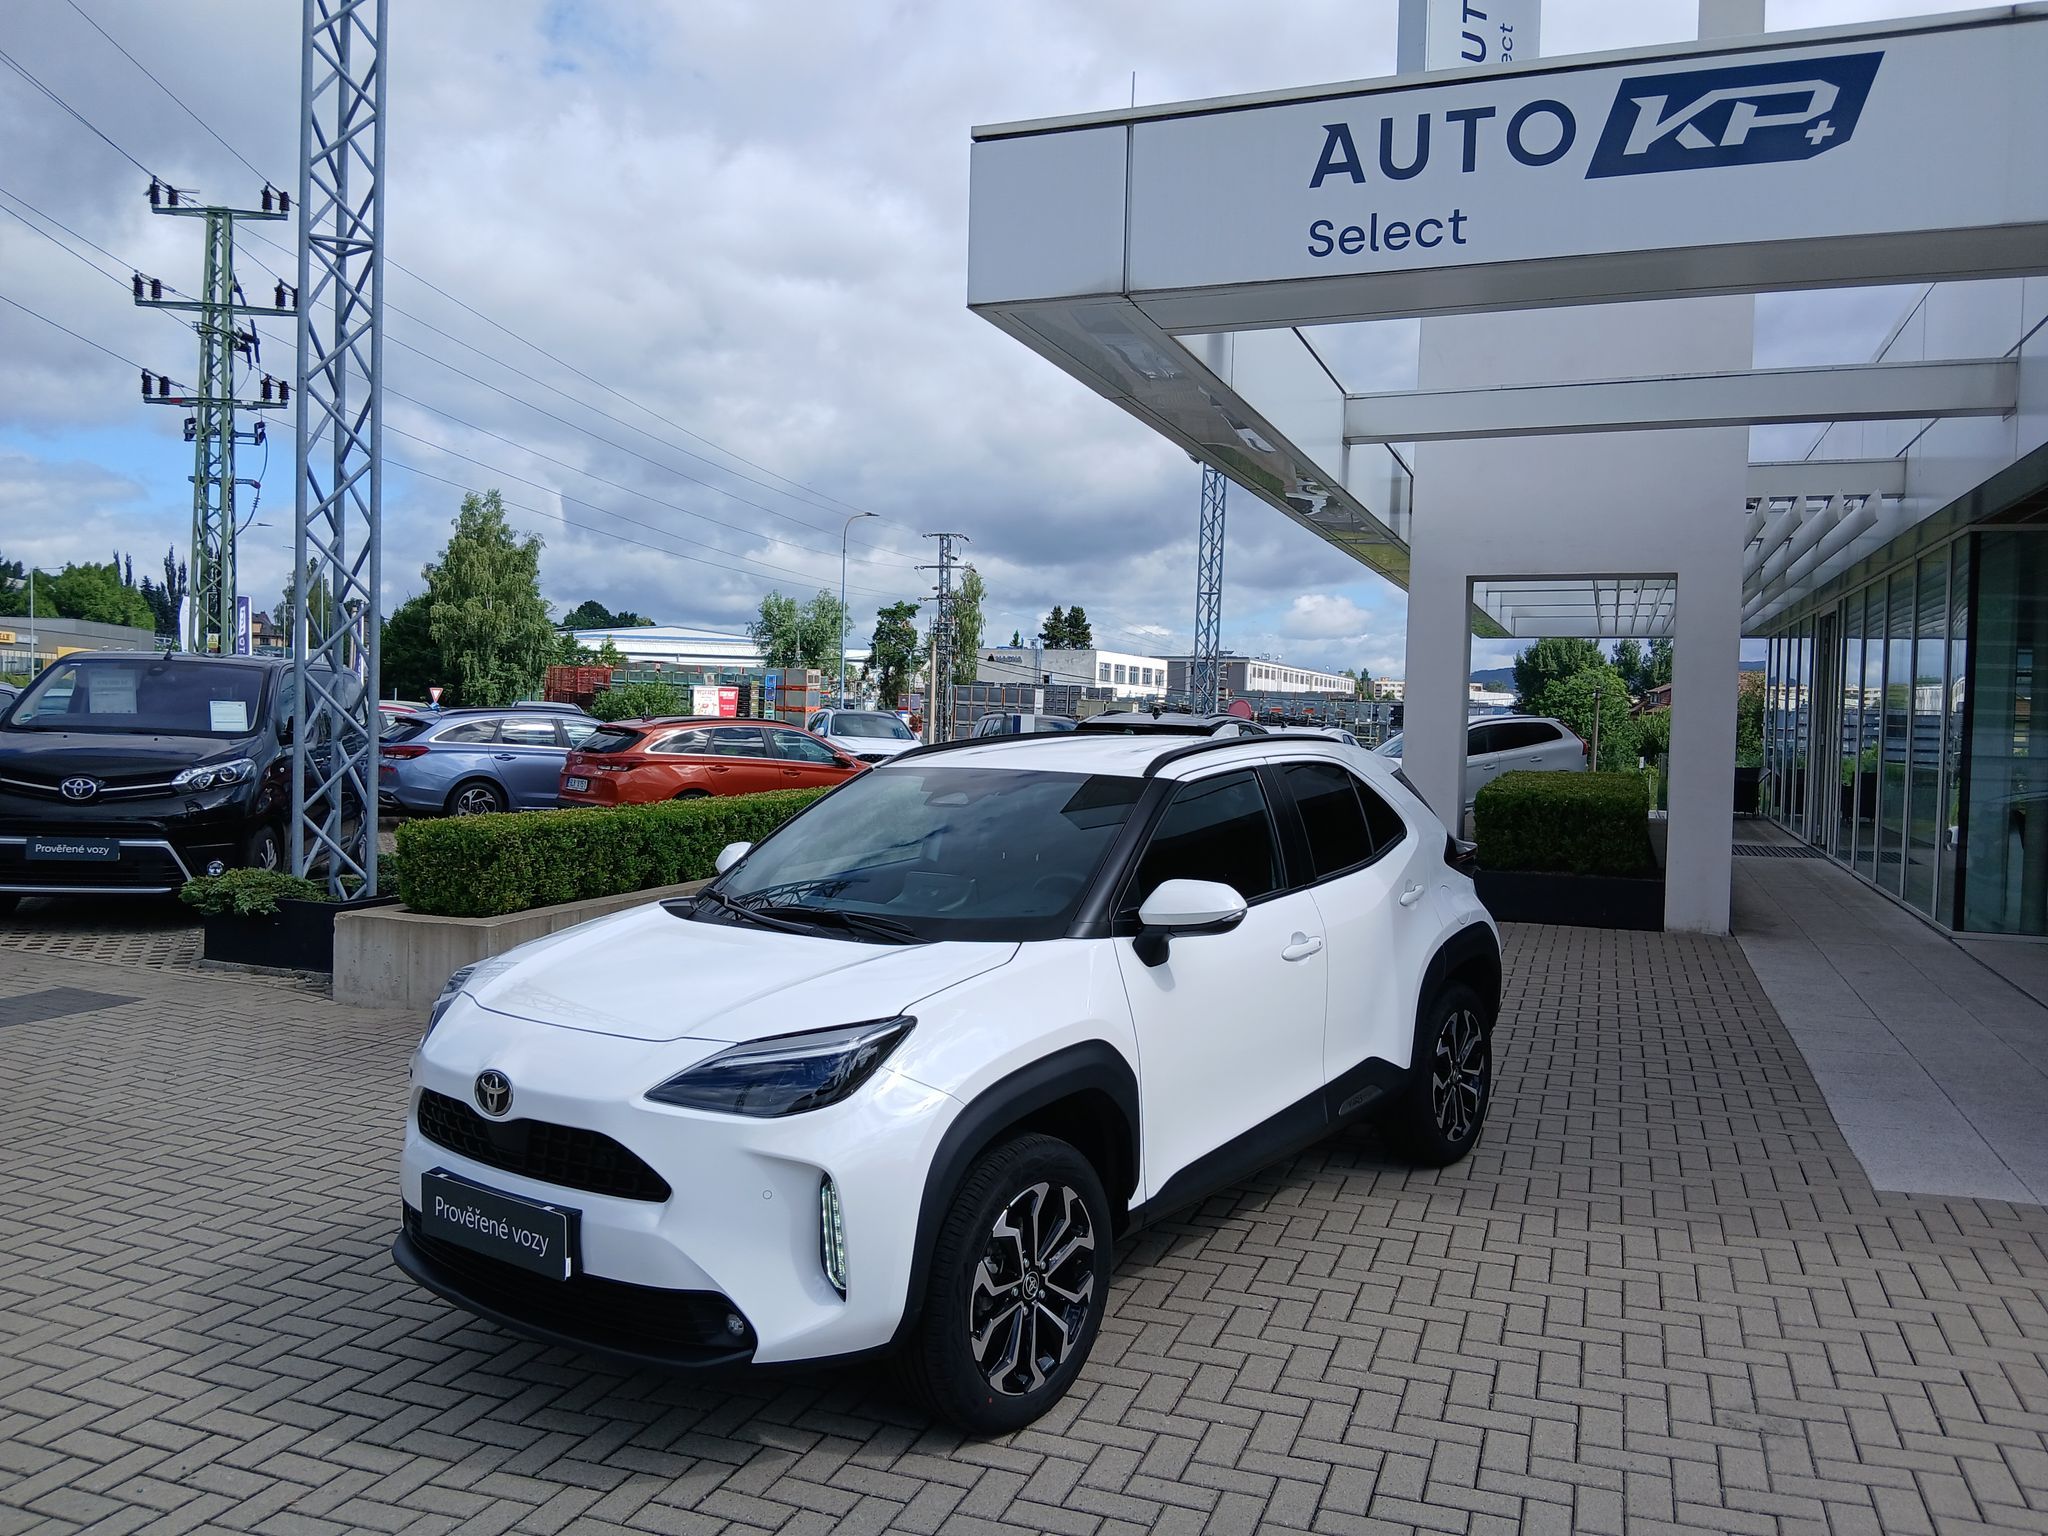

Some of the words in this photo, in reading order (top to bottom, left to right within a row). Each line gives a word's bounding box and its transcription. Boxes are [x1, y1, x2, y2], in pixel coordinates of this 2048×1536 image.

[1461, 0, 1487, 63] UT
[1499, 22, 1513, 63] ect
[1308, 99, 1577, 189] AUTO
[1307, 208, 1468, 258] Select
[35, 843, 84, 853] Prověřené
[86, 846, 110, 856] vozy
[435, 1196, 509, 1240] Prověřené
[512, 1226, 549, 1257] vozy
